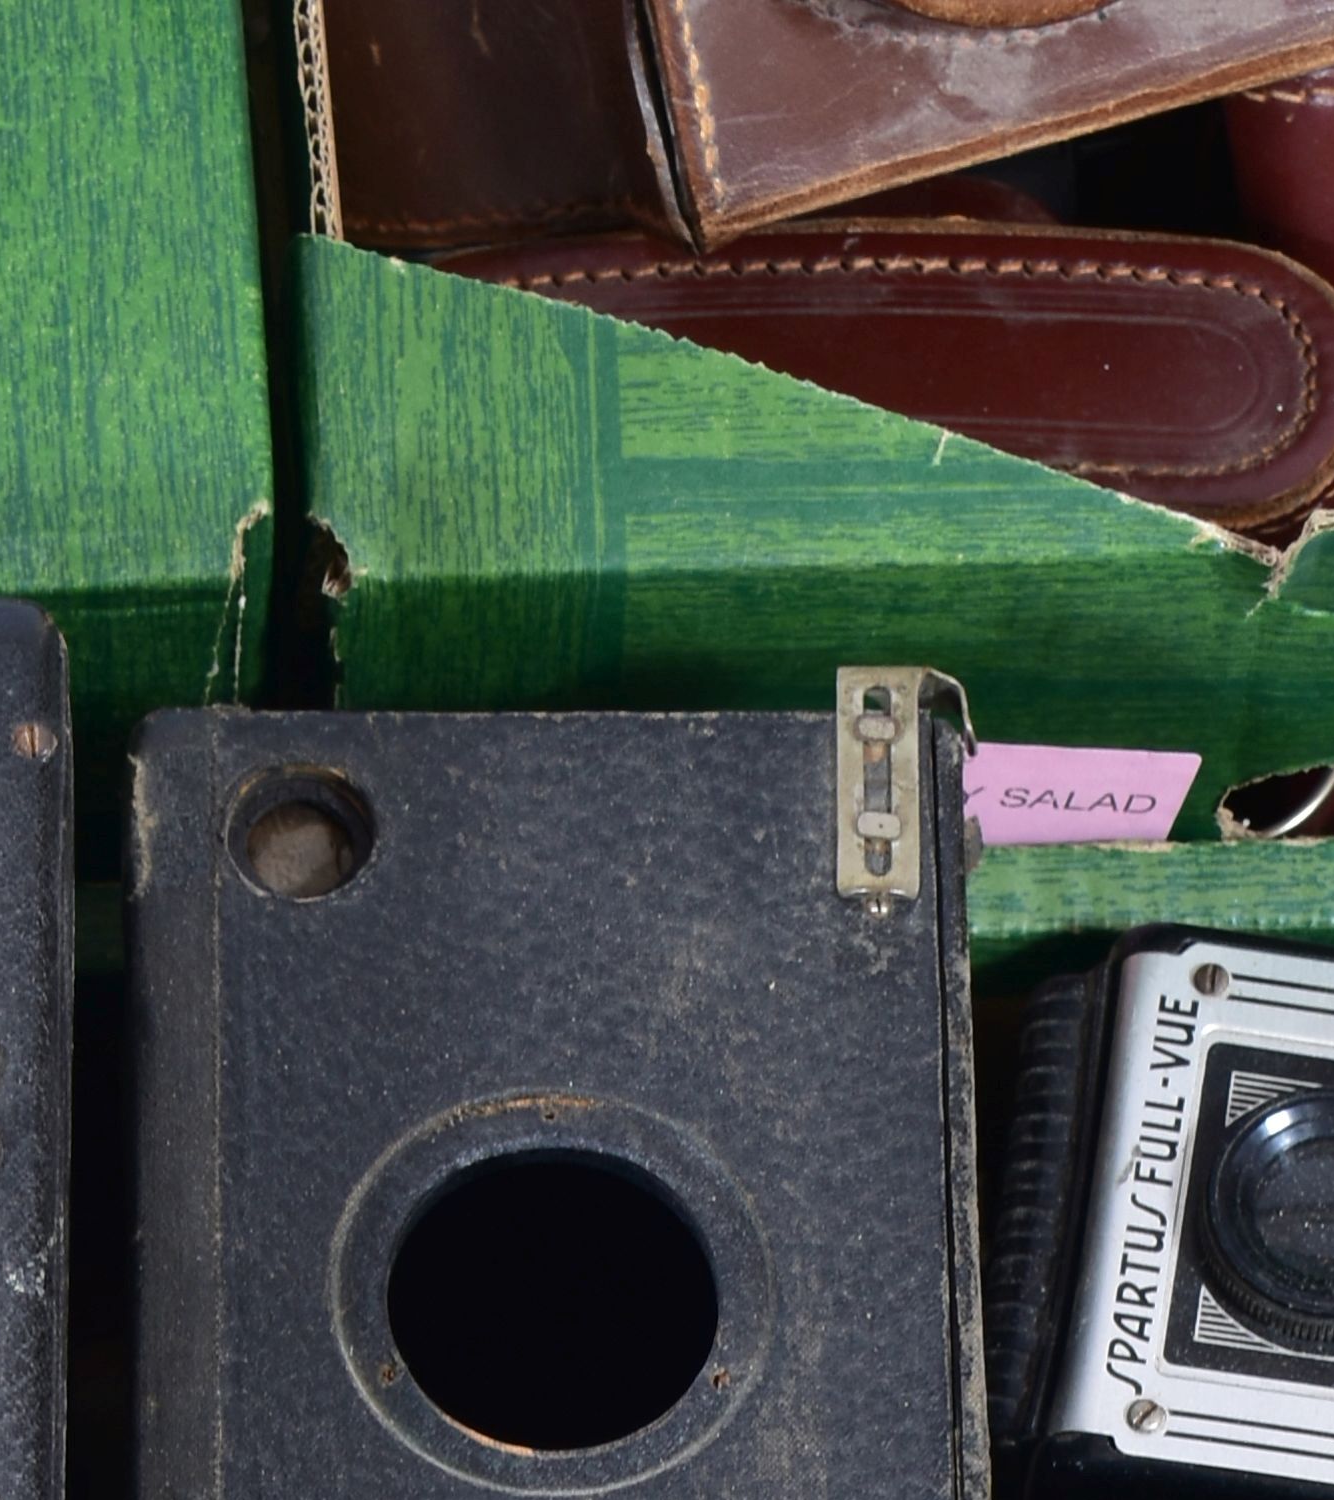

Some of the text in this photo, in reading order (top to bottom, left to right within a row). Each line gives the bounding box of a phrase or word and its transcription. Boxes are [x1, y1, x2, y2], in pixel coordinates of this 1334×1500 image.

[999, 788, 1158, 815] SALAD
[1105, 993, 1200, 1395] SPARTUS FULL-VUE
